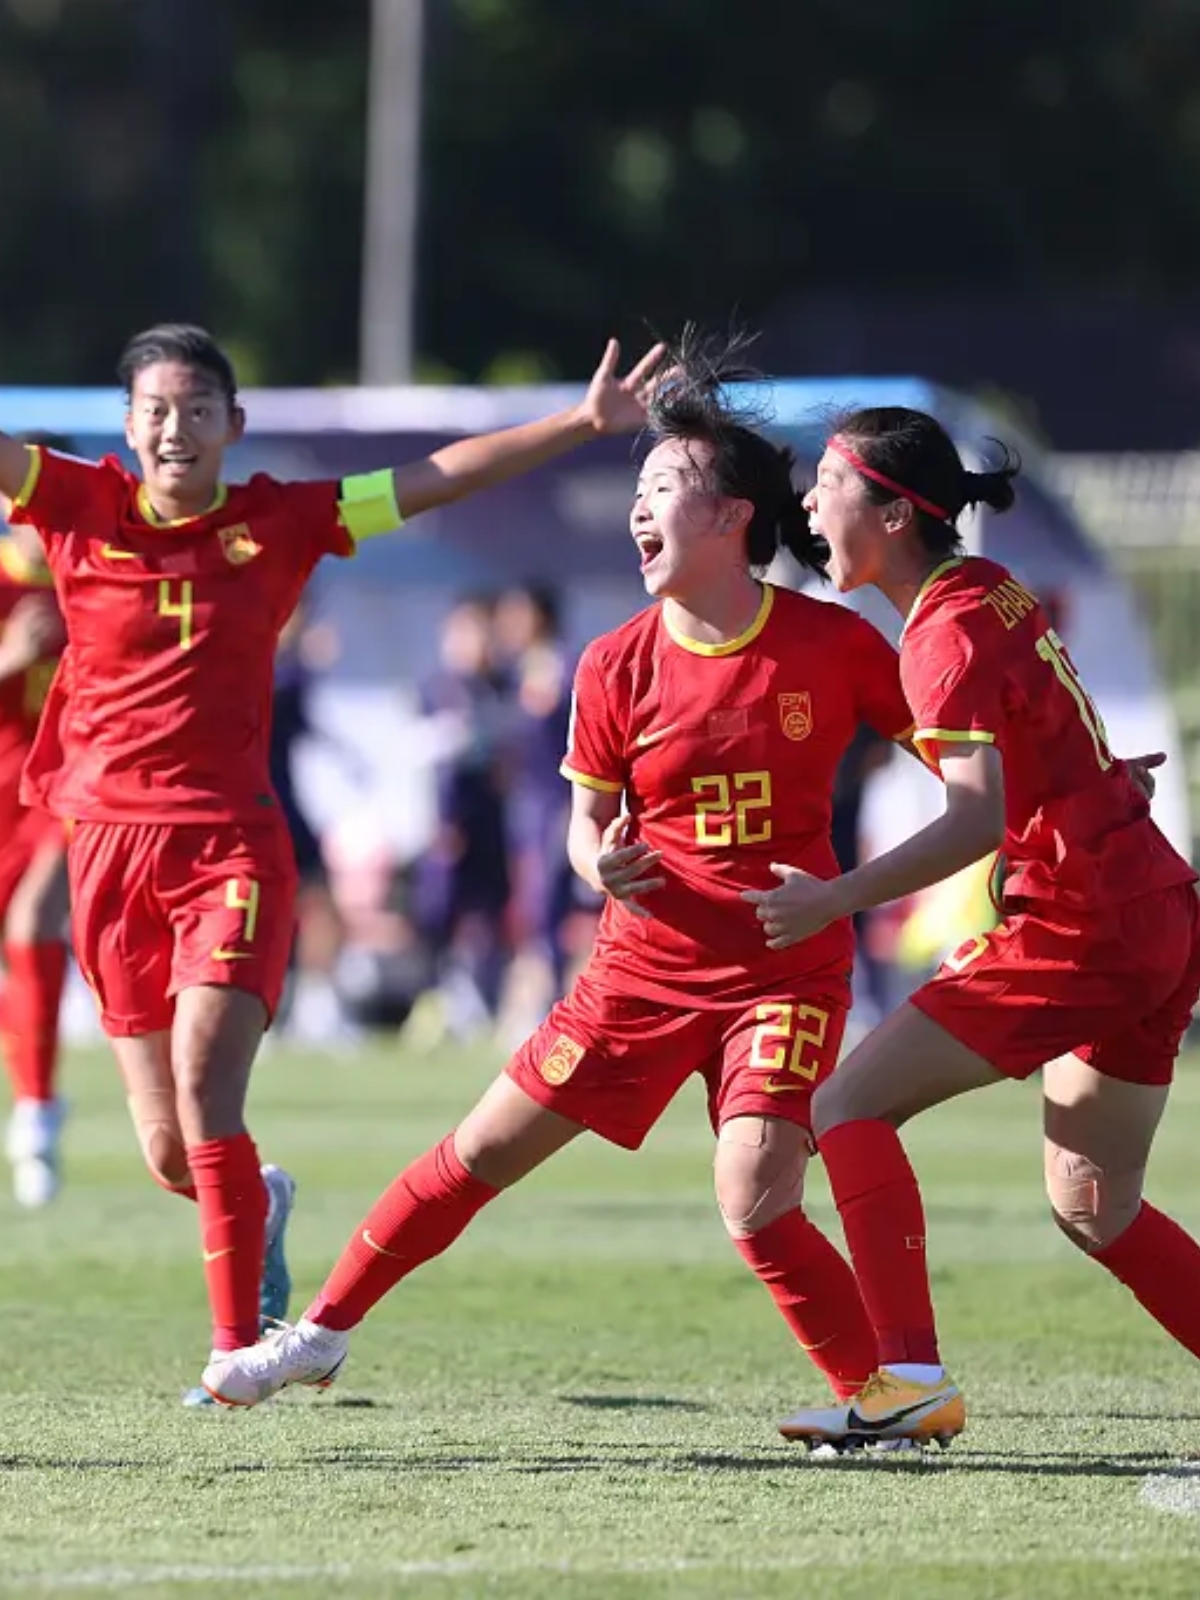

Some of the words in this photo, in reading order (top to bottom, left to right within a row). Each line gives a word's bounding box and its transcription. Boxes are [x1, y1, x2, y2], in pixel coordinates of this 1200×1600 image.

[158, 579, 193, 651] 4
[690, 770, 772, 847] 22
[226, 878, 260, 942] 4
[748, 1003, 829, 1082] 22
